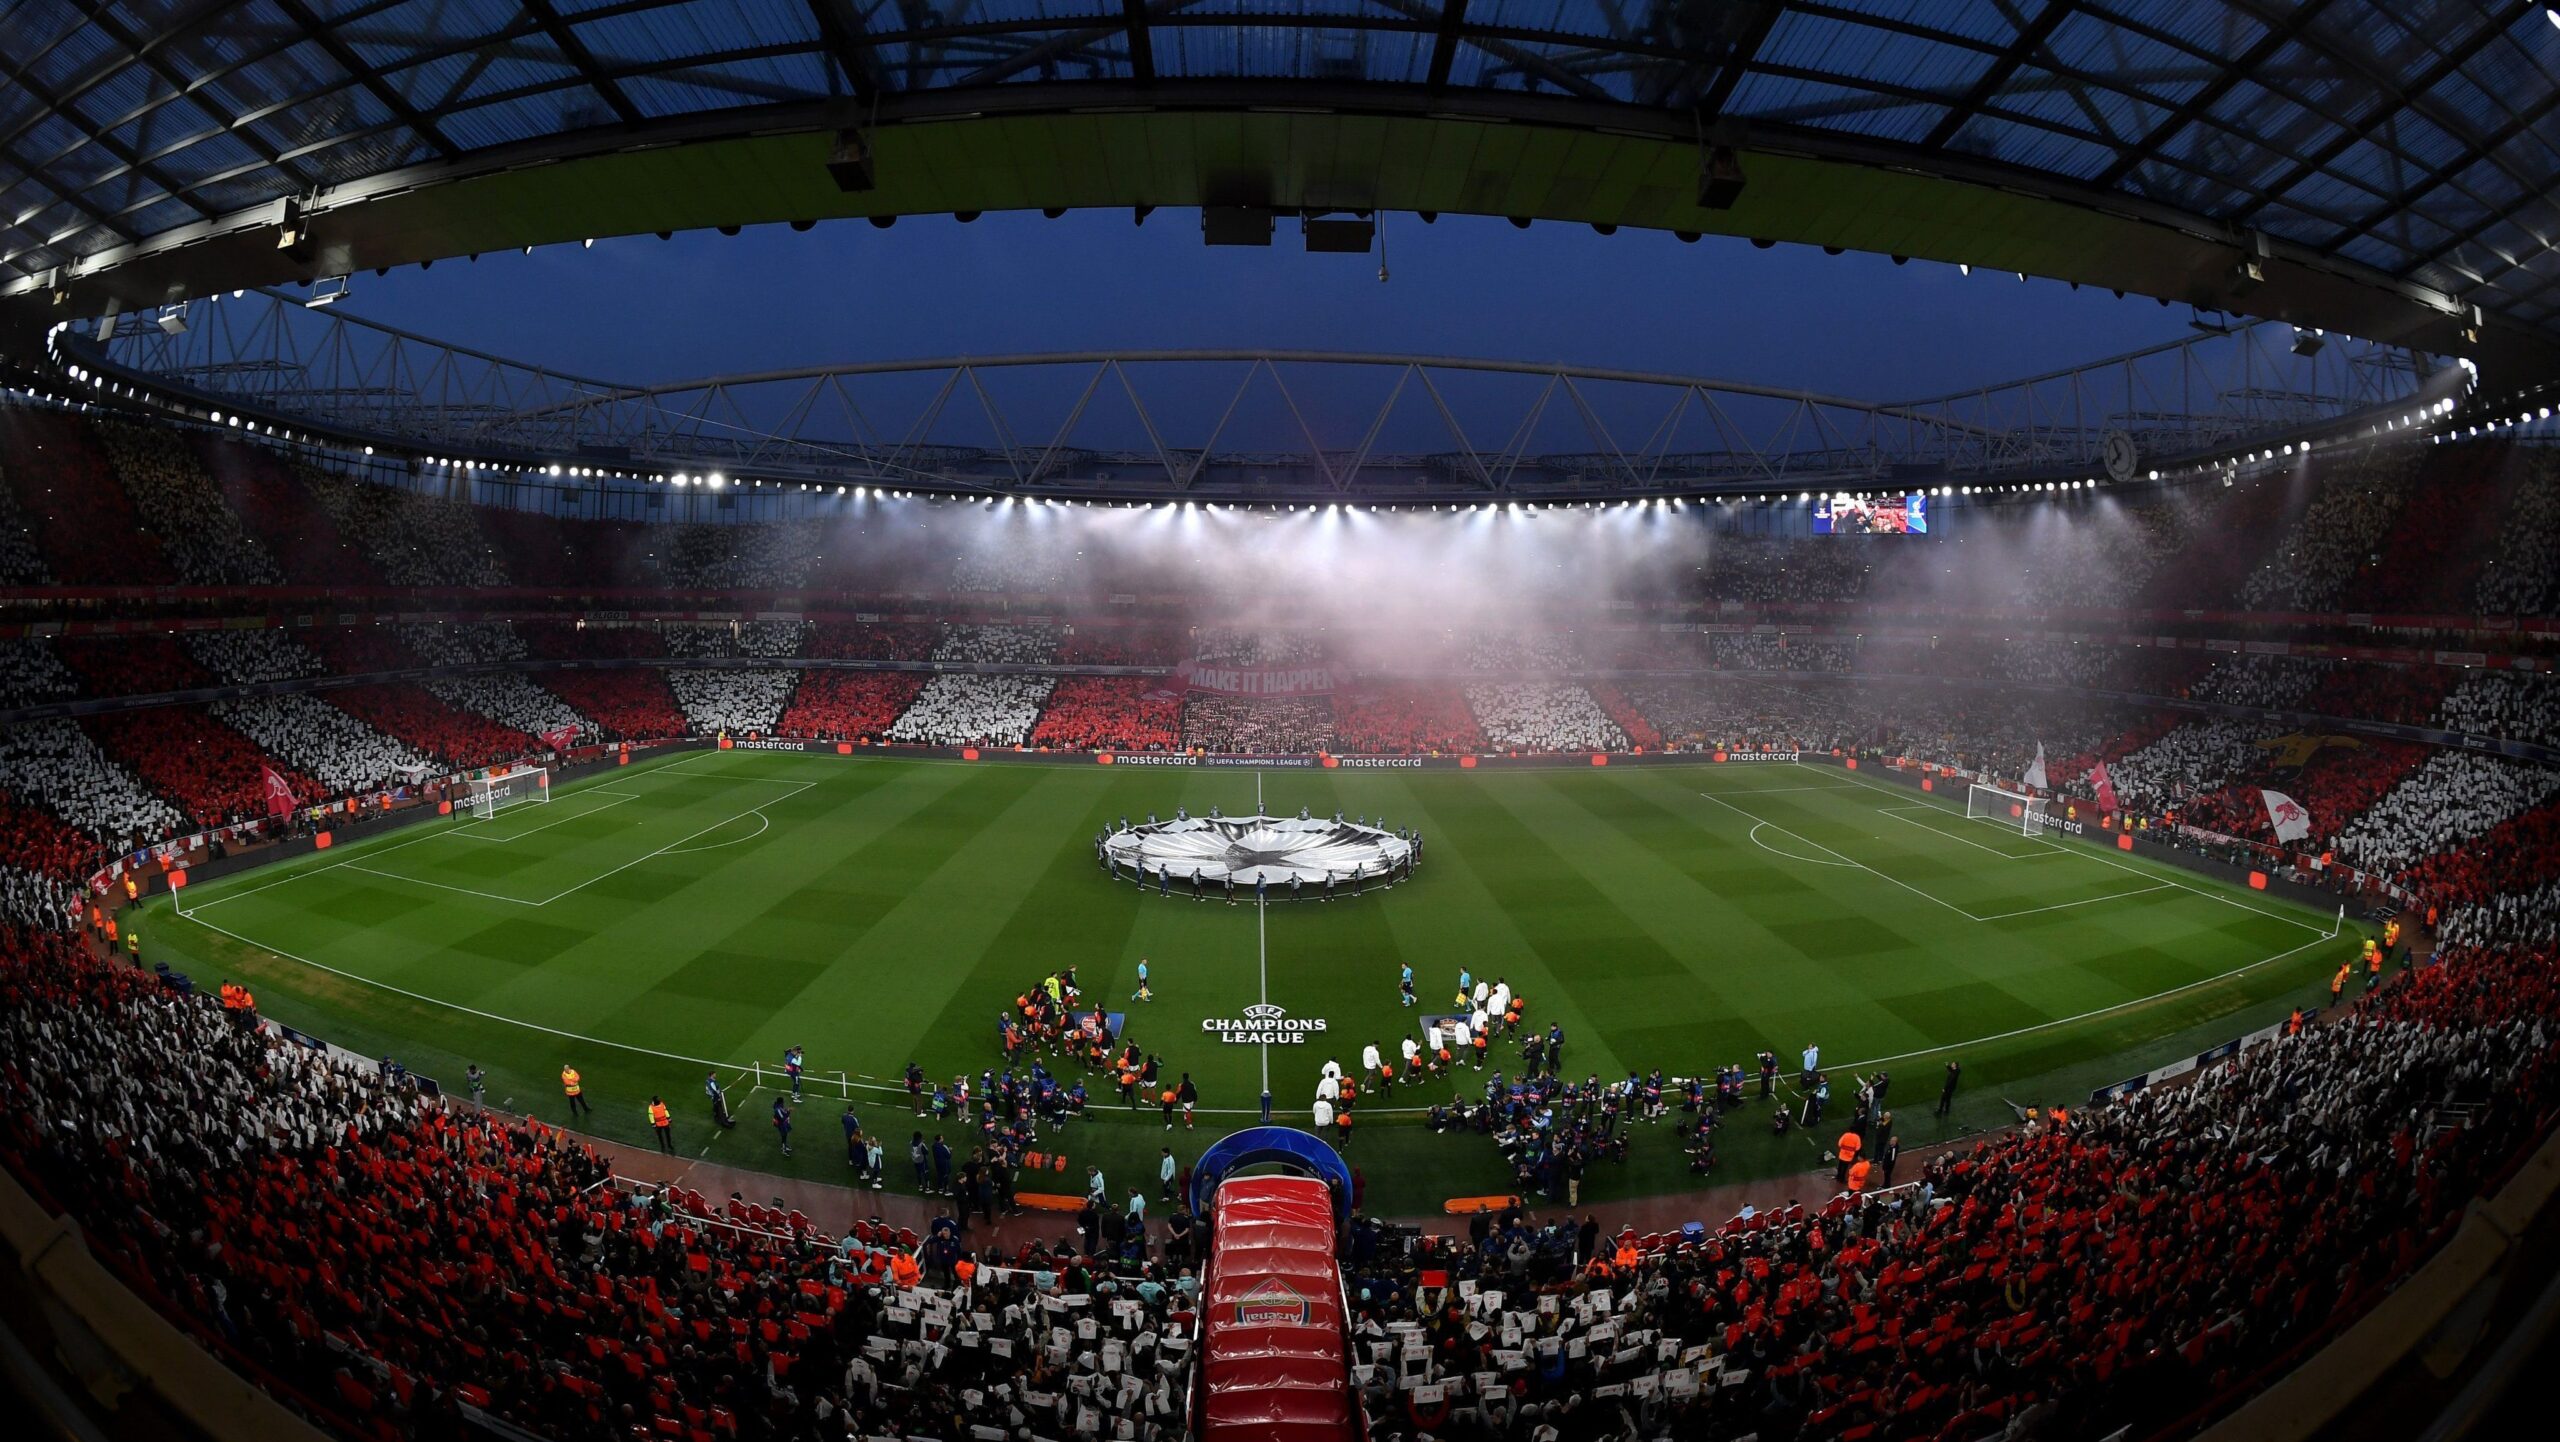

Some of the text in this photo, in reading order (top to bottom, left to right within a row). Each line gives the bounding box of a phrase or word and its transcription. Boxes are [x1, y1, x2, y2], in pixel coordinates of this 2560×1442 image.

[1189, 667, 1240, 692] MAKE
[1242, 671, 1258, 693] IT
[736, 739, 804, 751] mastercard
[1116, 754, 1197, 766] mastercard
[1342, 756, 1422, 767] mastercard
[1730, 751, 1798, 761] mastercard
[1244, 1006, 1283, 1018] UEFA
[1202, 1019, 1327, 1031] CHAMPIONS
[1222, 1032, 1305, 1044] LEAGUE
[1246, 1311, 1301, 1322] Arsenal
